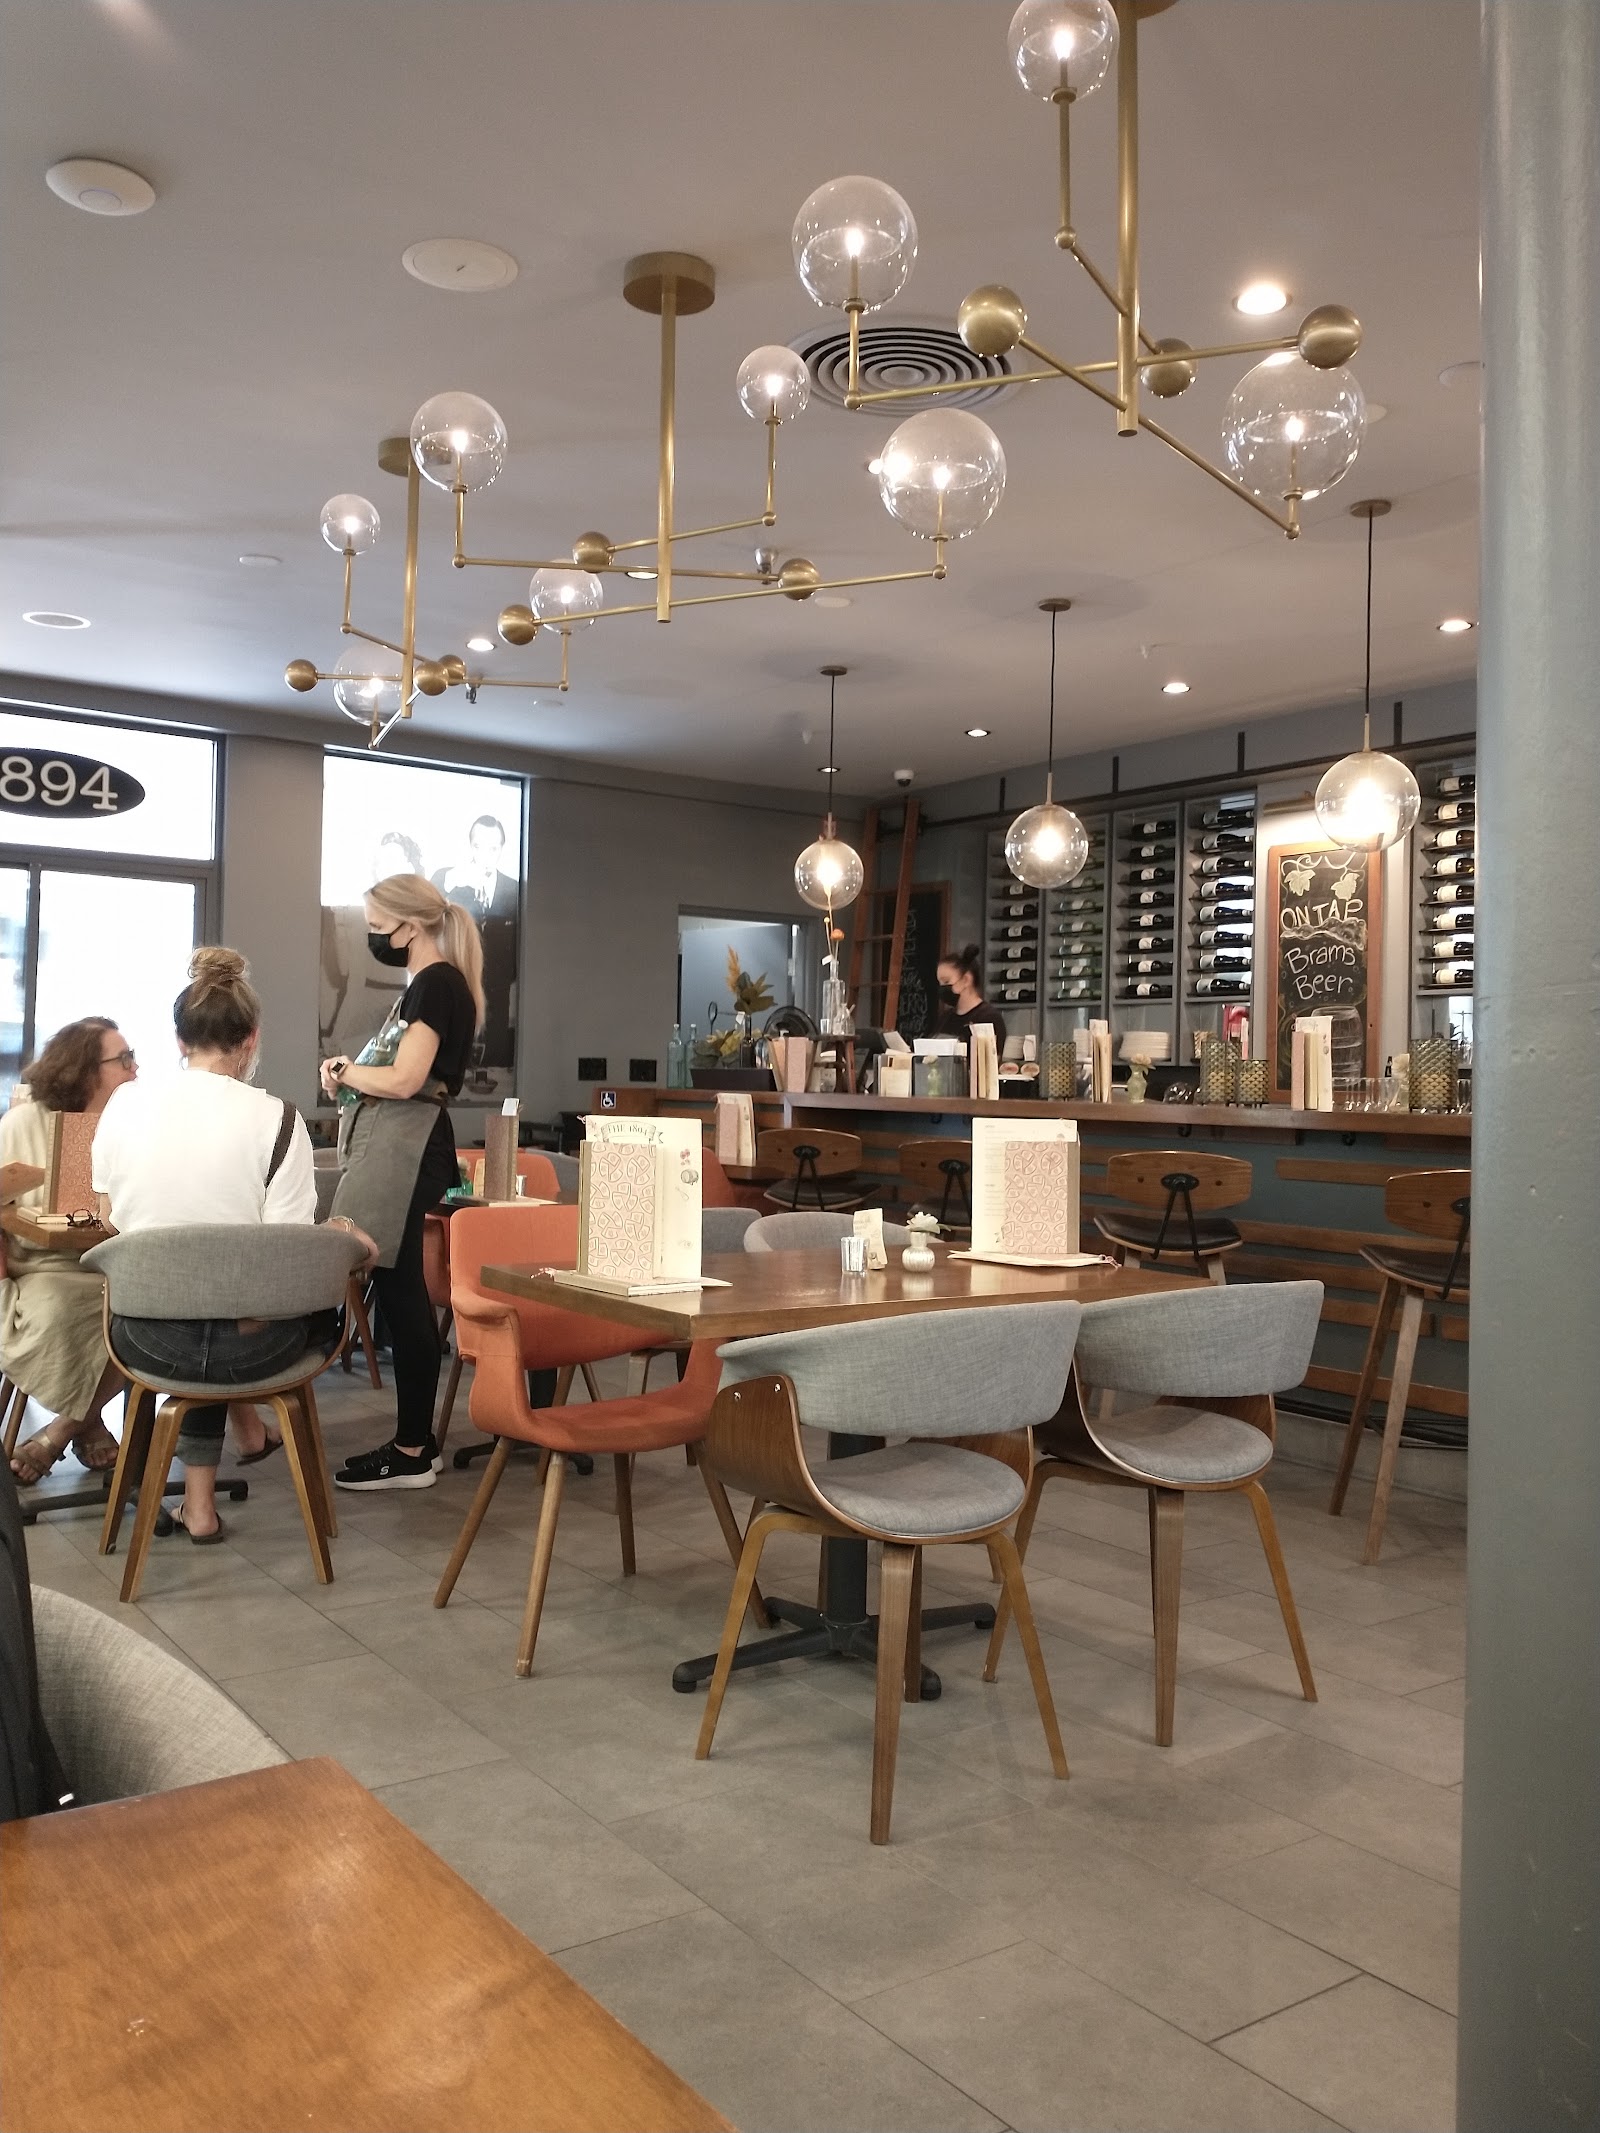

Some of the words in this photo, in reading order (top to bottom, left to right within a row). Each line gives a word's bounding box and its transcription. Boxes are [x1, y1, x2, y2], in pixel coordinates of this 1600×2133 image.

[0, 756, 118, 811] 894
[1280, 906, 1311, 931] ON
[1312, 899, 1364, 926] TAP
[1292, 974, 1353, 1000] Beer
